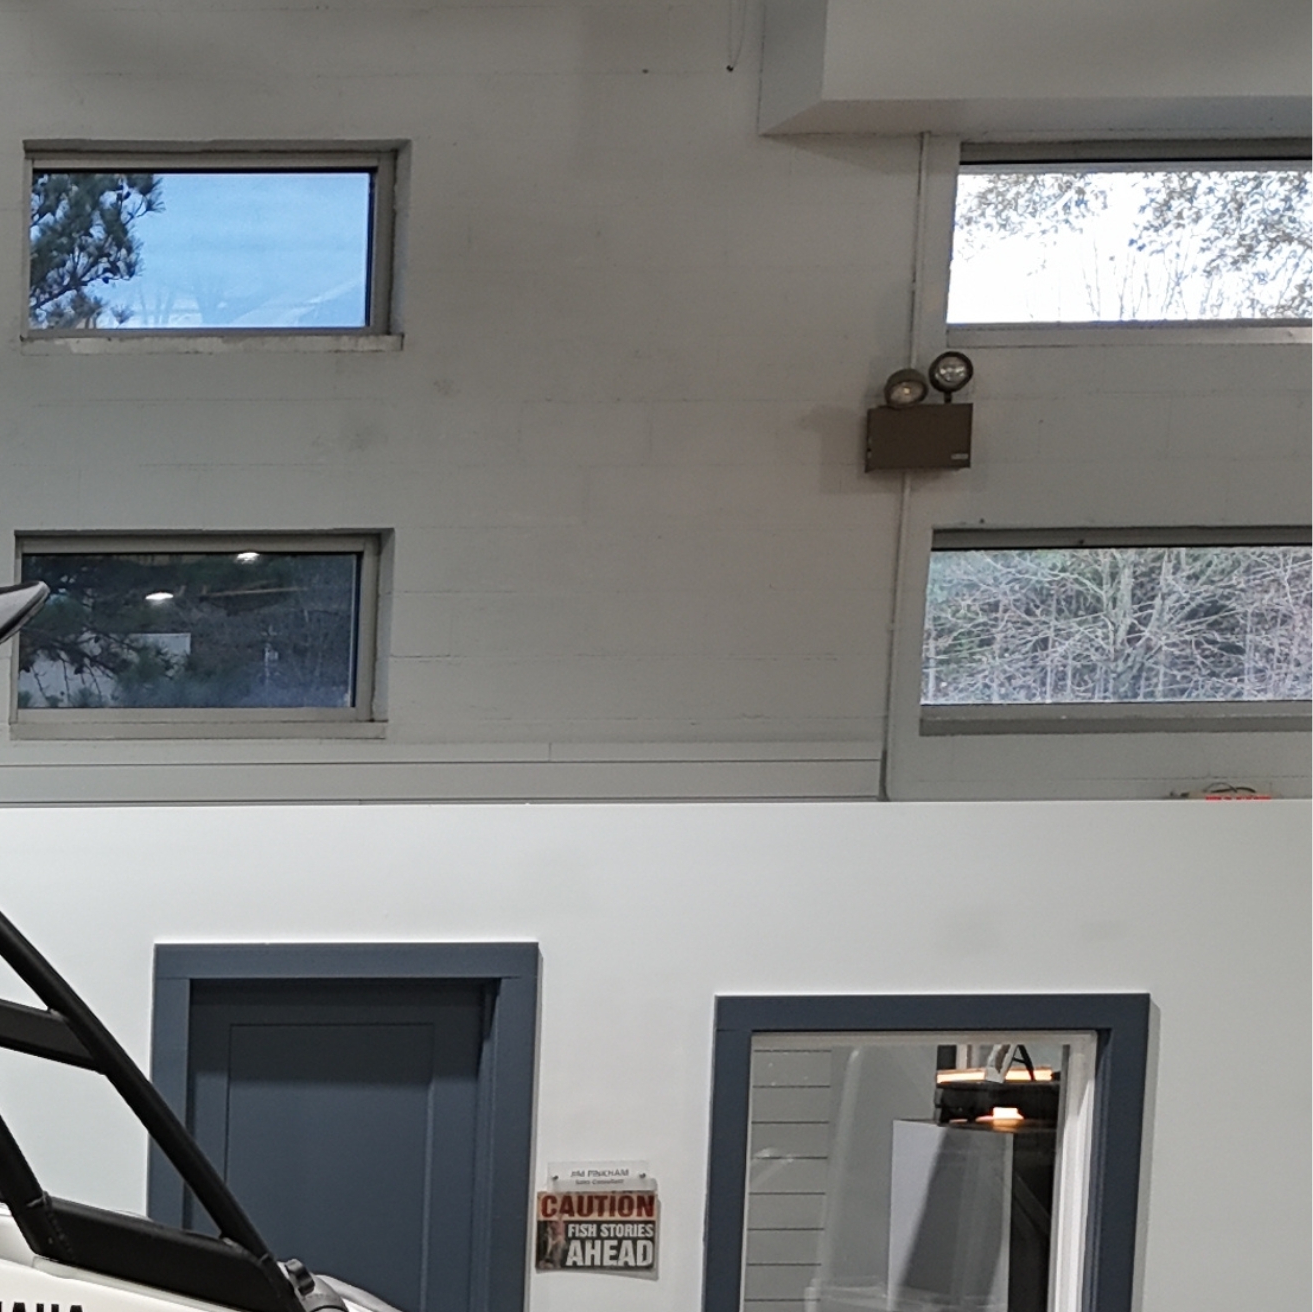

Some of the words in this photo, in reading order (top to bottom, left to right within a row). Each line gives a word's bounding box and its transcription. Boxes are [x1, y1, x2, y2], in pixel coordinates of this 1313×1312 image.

[541, 1194, 655, 1218] CAUTION
[568, 1223, 597, 1238] FISH
[600, 1223, 654, 1238] STORIES
[565, 1240, 654, 1267] AHEAD
